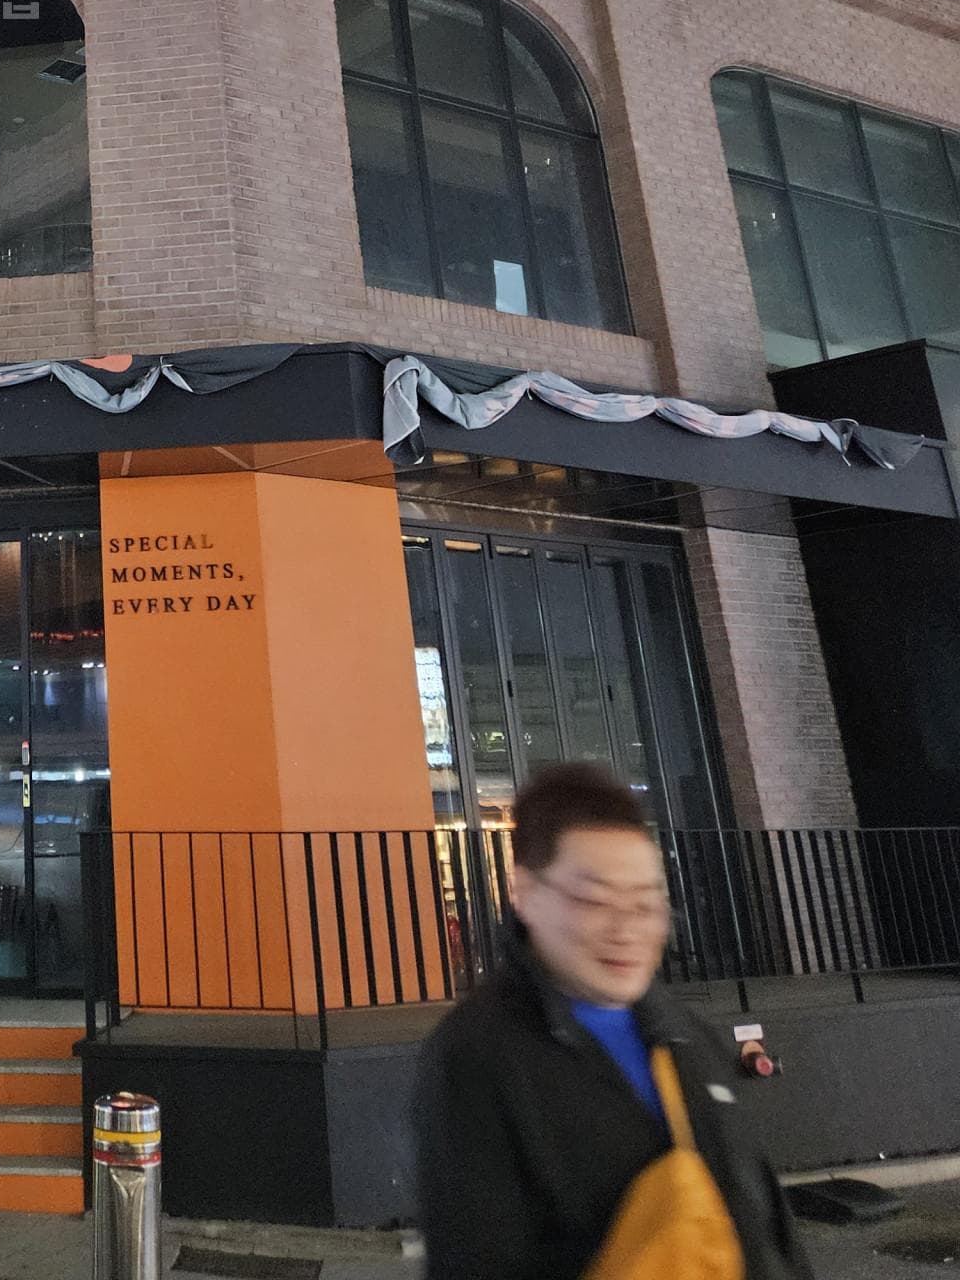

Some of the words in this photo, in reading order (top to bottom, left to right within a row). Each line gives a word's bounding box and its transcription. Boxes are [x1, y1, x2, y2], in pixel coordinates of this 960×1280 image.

[109, 534, 214, 553] SPECIAL
[111, 563, 245, 583] MOMENTS,
[112, 597, 193, 615] EVERY
[207, 594, 256, 611] DAY
